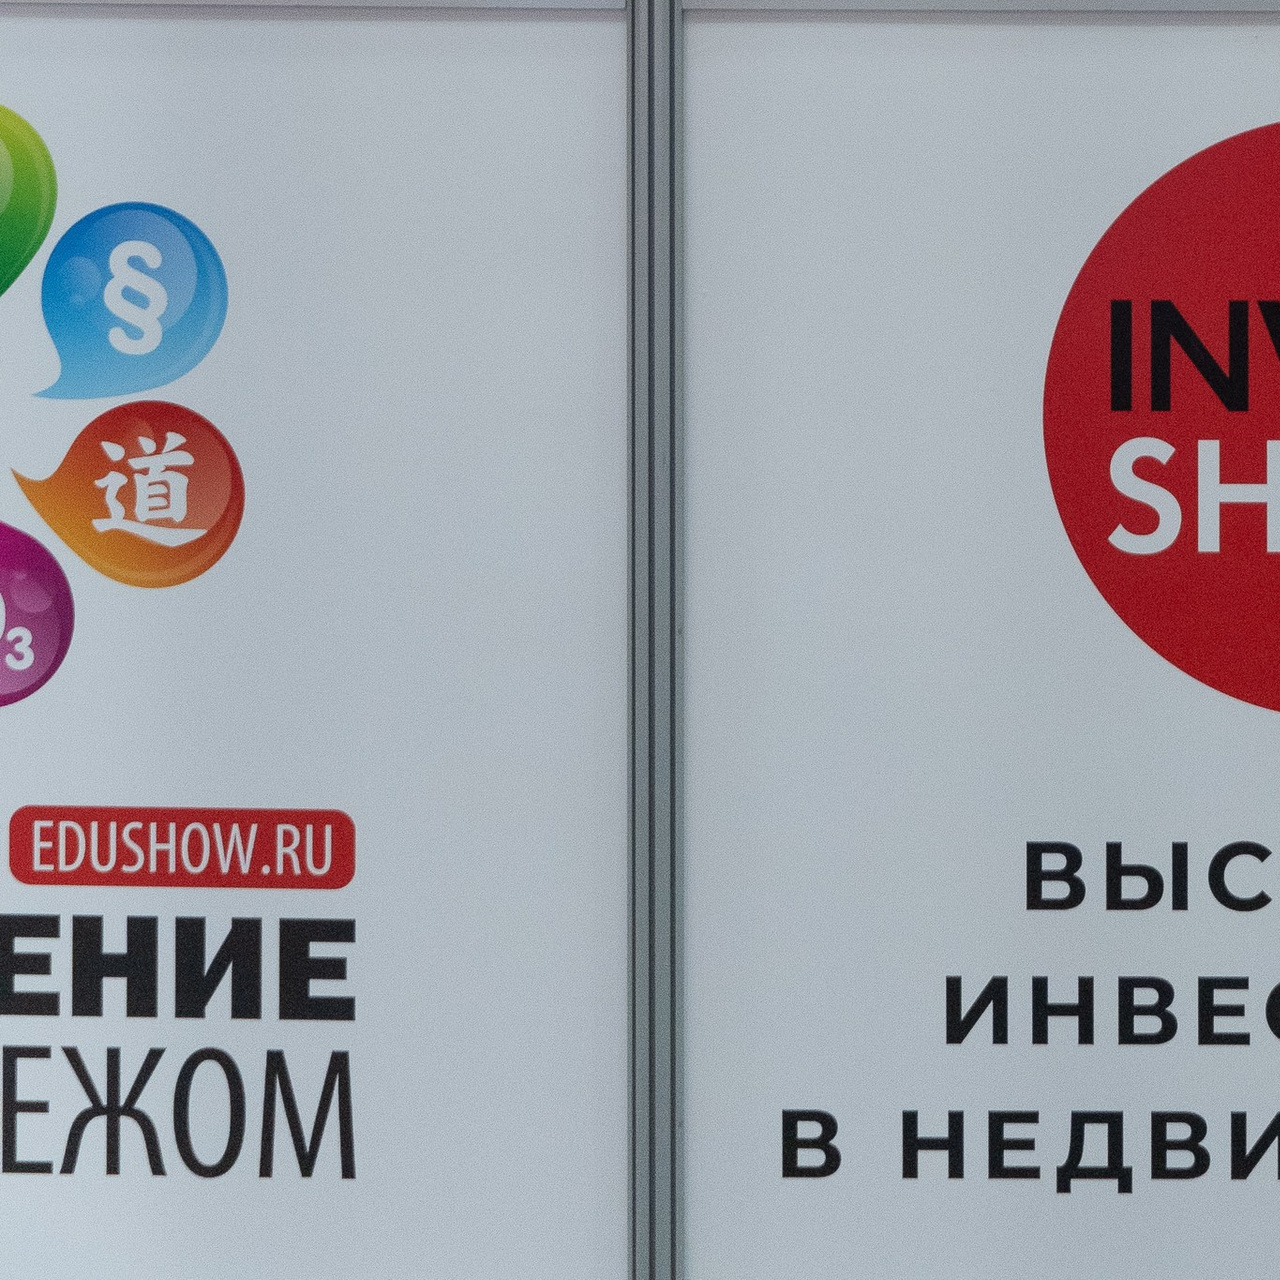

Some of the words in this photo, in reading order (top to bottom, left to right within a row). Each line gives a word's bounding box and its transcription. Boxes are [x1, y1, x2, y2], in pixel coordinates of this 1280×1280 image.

[92, 431, 208, 547] 道
[32, 820, 334, 877] EDUSHOW.RU
[0, 914, 356, 1021] ЕНИЕ
[2, 1046, 357, 1180] ЕЖОМ
[780, 1108, 843, 1180] В
